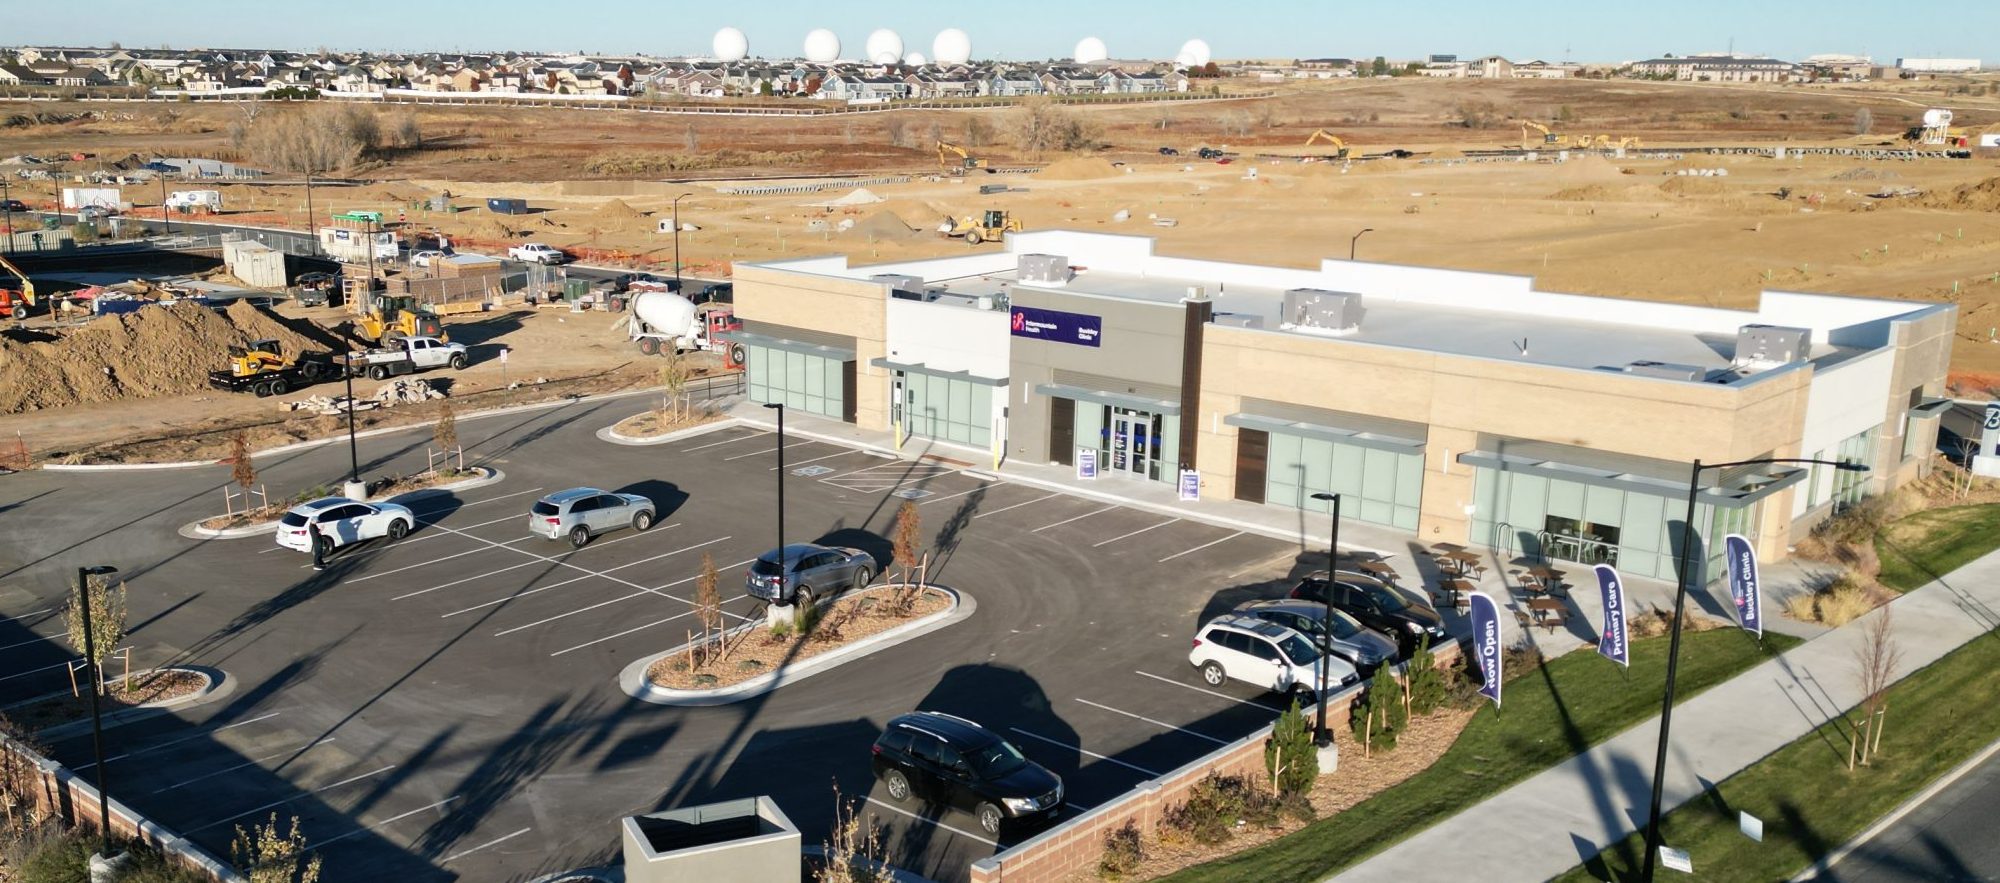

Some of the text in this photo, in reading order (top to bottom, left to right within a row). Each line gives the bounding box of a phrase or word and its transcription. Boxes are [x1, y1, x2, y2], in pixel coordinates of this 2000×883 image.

[1608, 581, 1618, 609] Care
[1741, 551, 1755, 621] Buckley Clinic
[1483, 620, 1497, 689] Now Open
[1610, 610, 1623, 656] Primary
